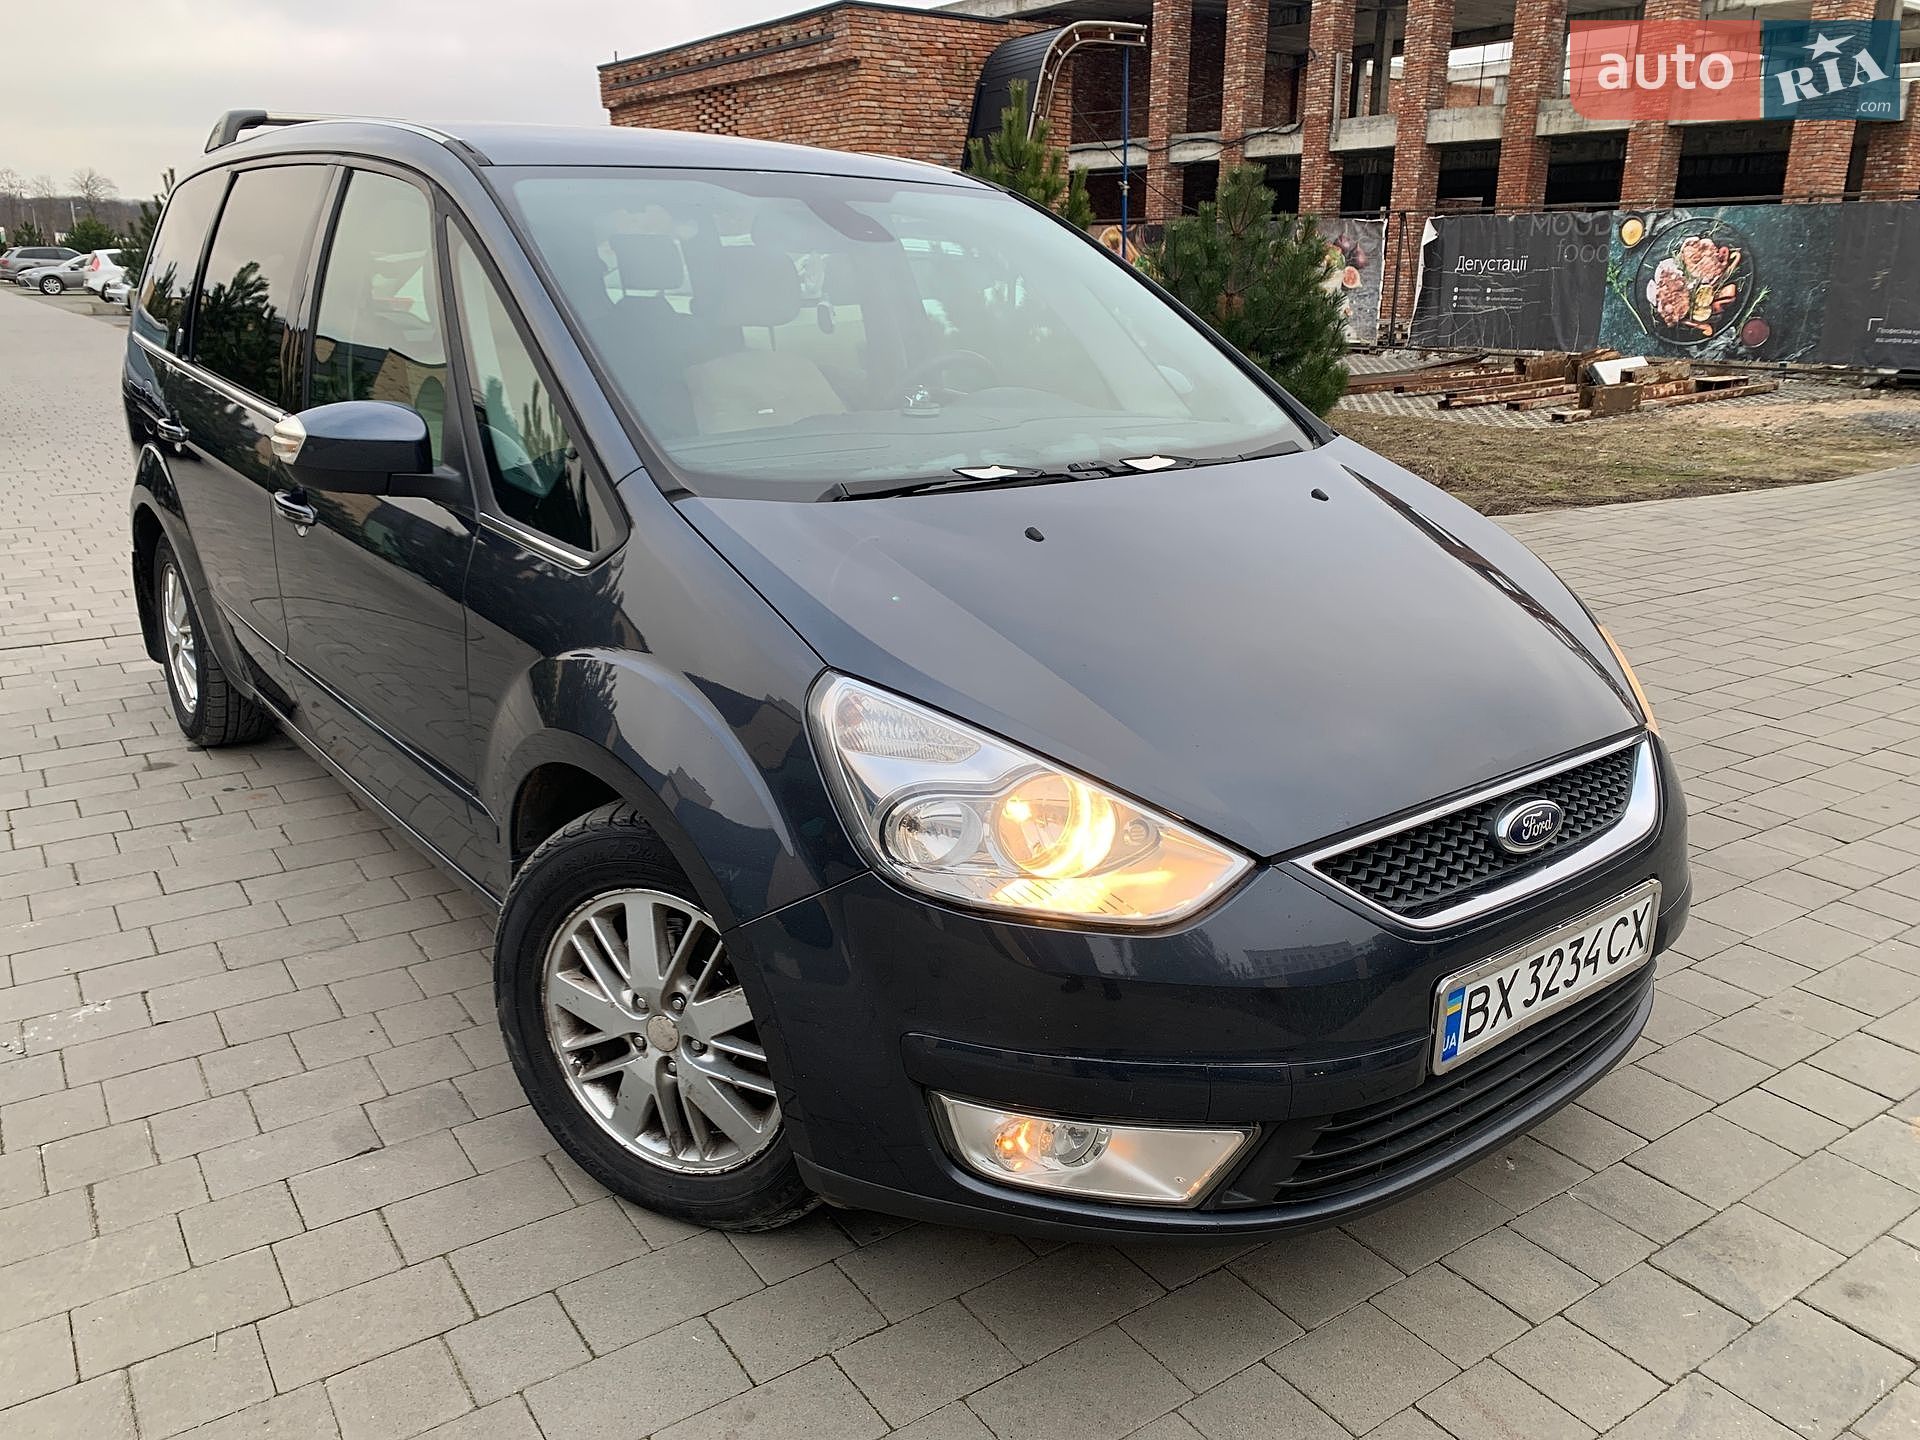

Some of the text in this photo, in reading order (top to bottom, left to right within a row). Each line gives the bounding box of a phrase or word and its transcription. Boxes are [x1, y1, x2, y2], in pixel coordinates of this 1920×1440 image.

[1454, 255, 1529, 275] Дегустації
[1521, 810, 1554, 841] Ford
[1442, 1032, 1457, 1052] UA
